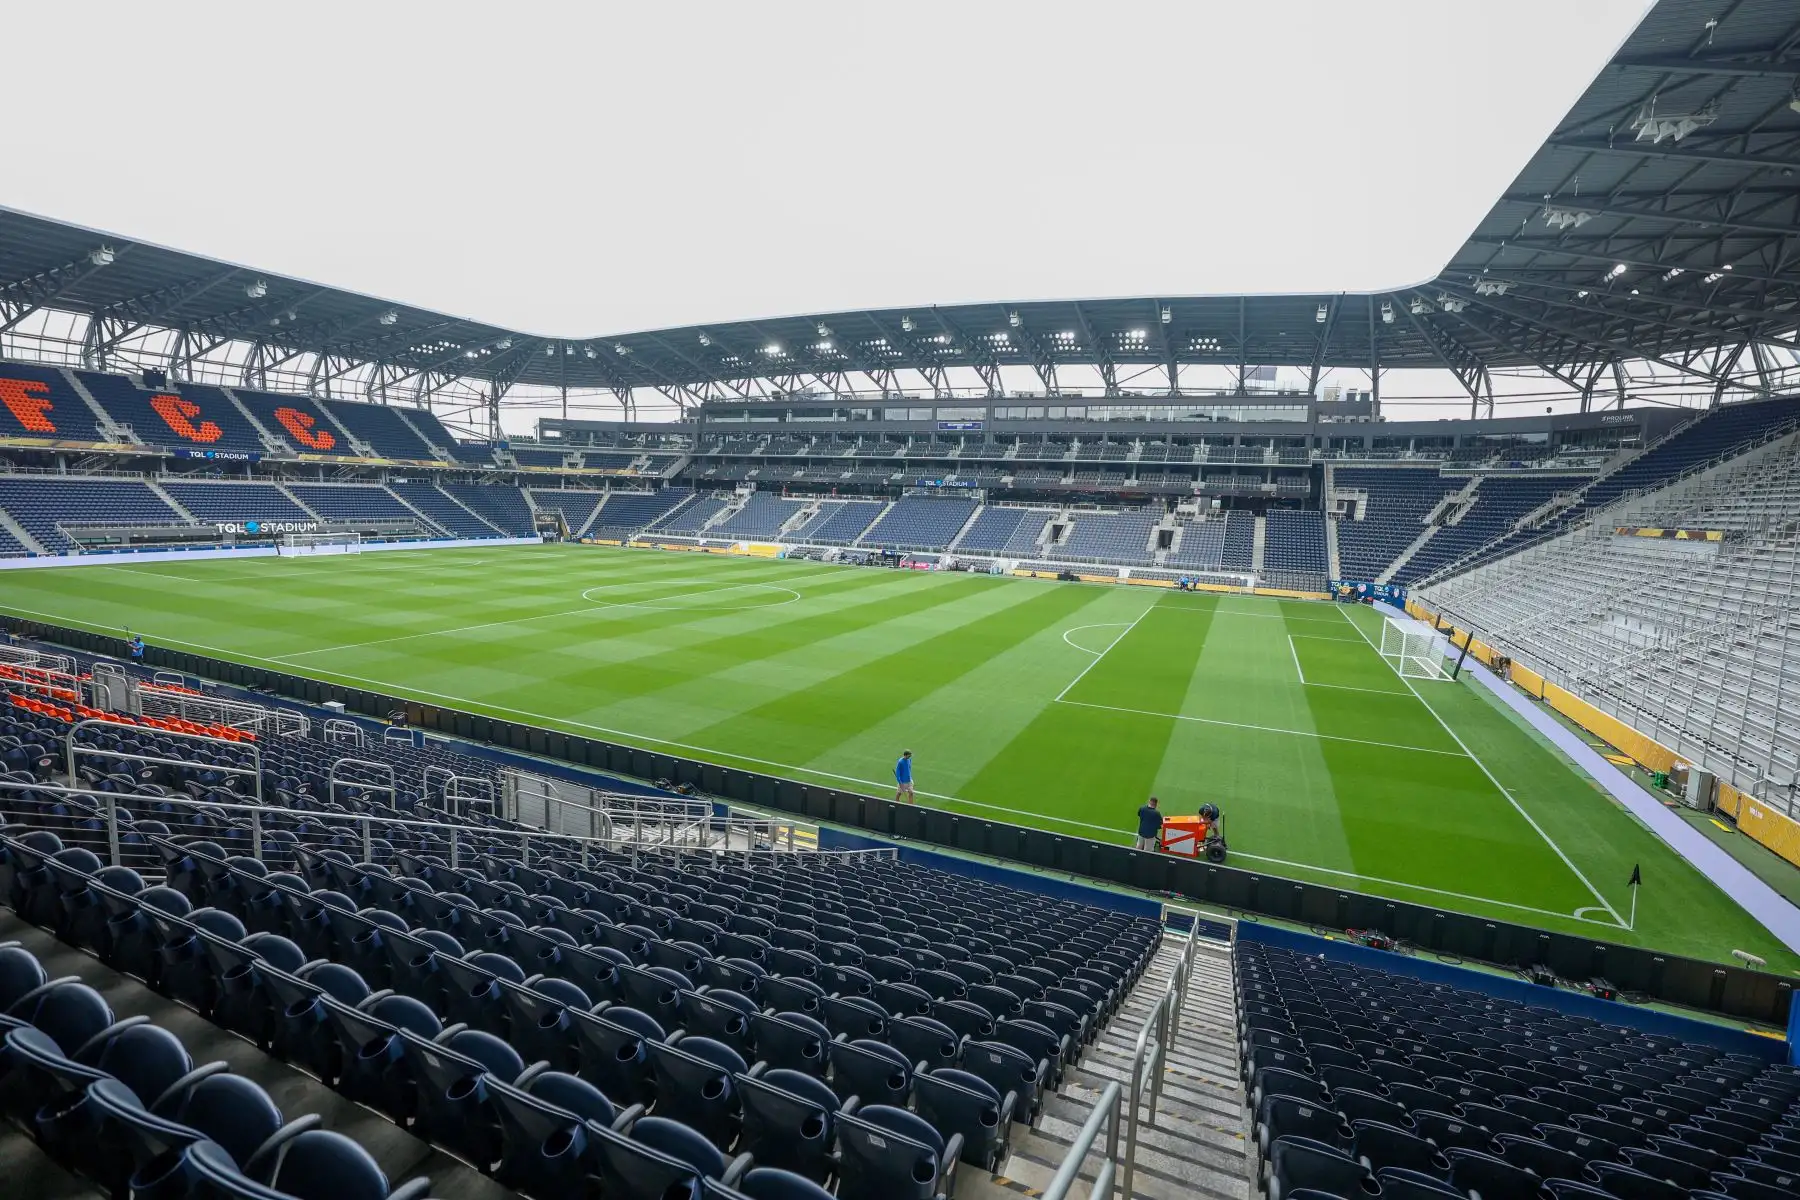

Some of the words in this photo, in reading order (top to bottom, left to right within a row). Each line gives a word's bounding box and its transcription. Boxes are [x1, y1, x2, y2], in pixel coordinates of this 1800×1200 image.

[214, 452, 249, 460] STADIUM
[215, 523, 246, 534] TQL
[260, 522, 317, 533] STADIUM
